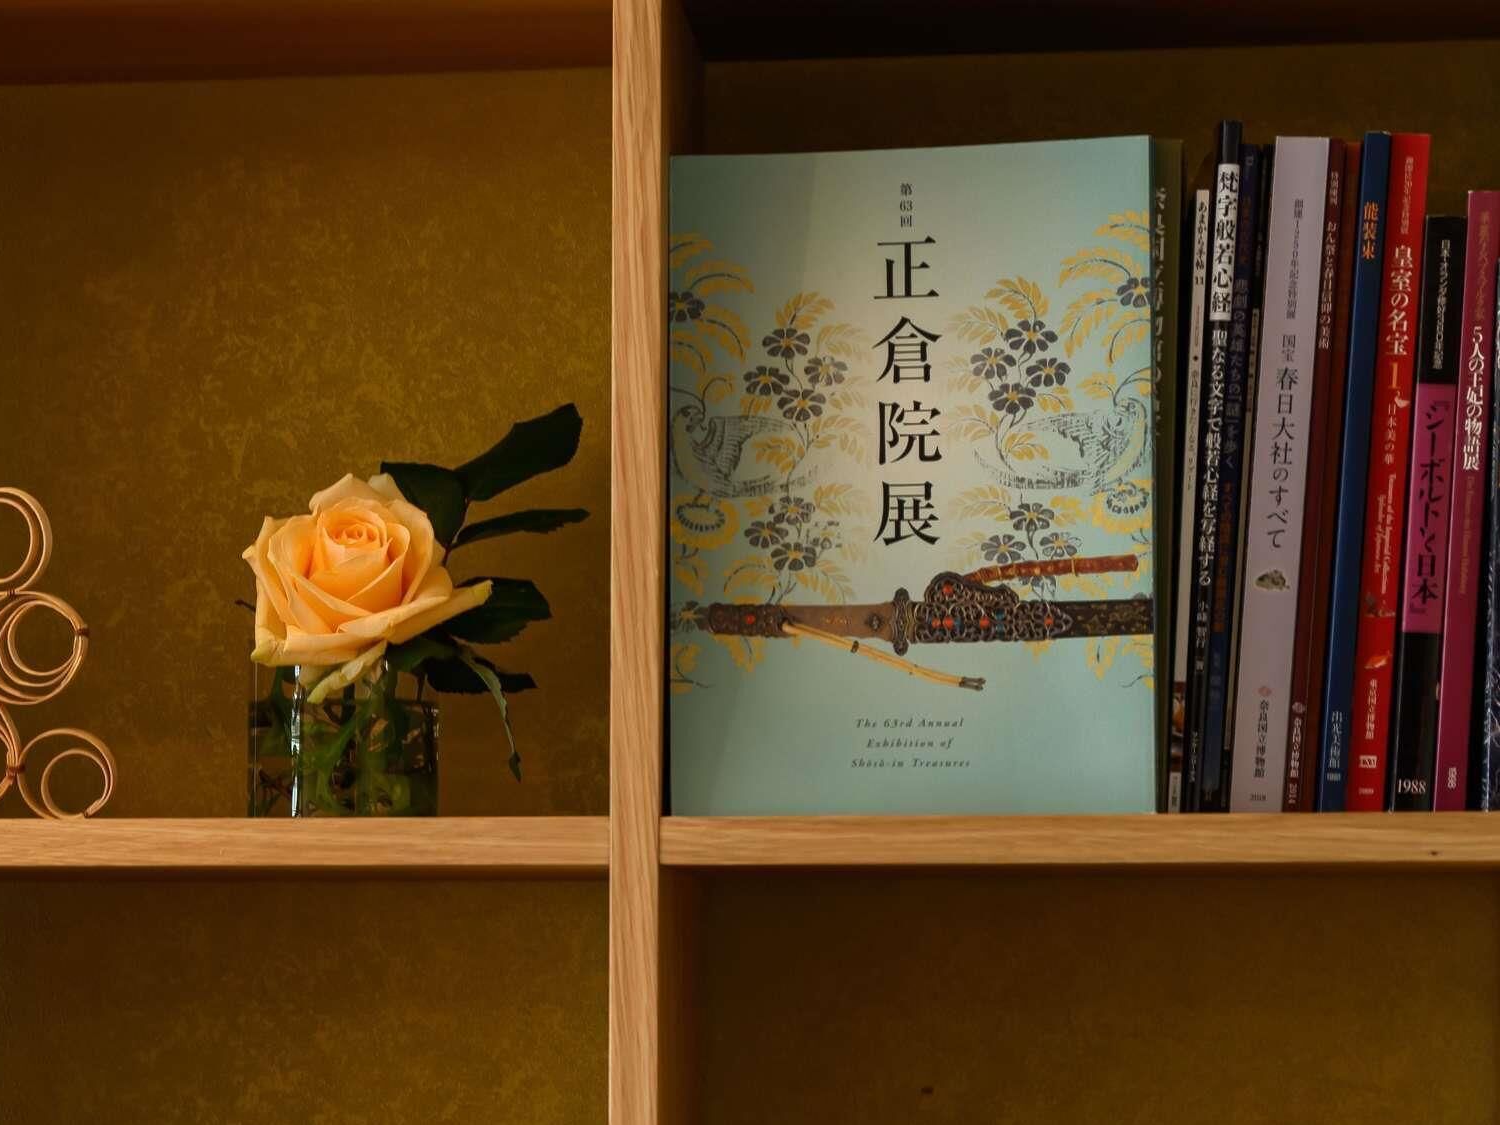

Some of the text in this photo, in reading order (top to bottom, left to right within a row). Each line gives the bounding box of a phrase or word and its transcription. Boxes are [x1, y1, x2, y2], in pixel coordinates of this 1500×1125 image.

[1211, 171, 1238, 314] 梵字般若心経
[1362, 201, 1379, 260] 能装束
[1386, 245, 1413, 356] 皇室の名宝
[873, 236, 942, 546] 正倉院展
[1462, 326, 1487, 471] 5人の王妃の物語展
[1267, 334, 1299, 549] 国宝 春日大社のすべて
[856, 717, 964, 728] The 63rd Annual
[866, 737, 955, 749] Exhibition of
[913, 758, 970, 768] Treasures
[1398, 778, 1426, 794] 1988
